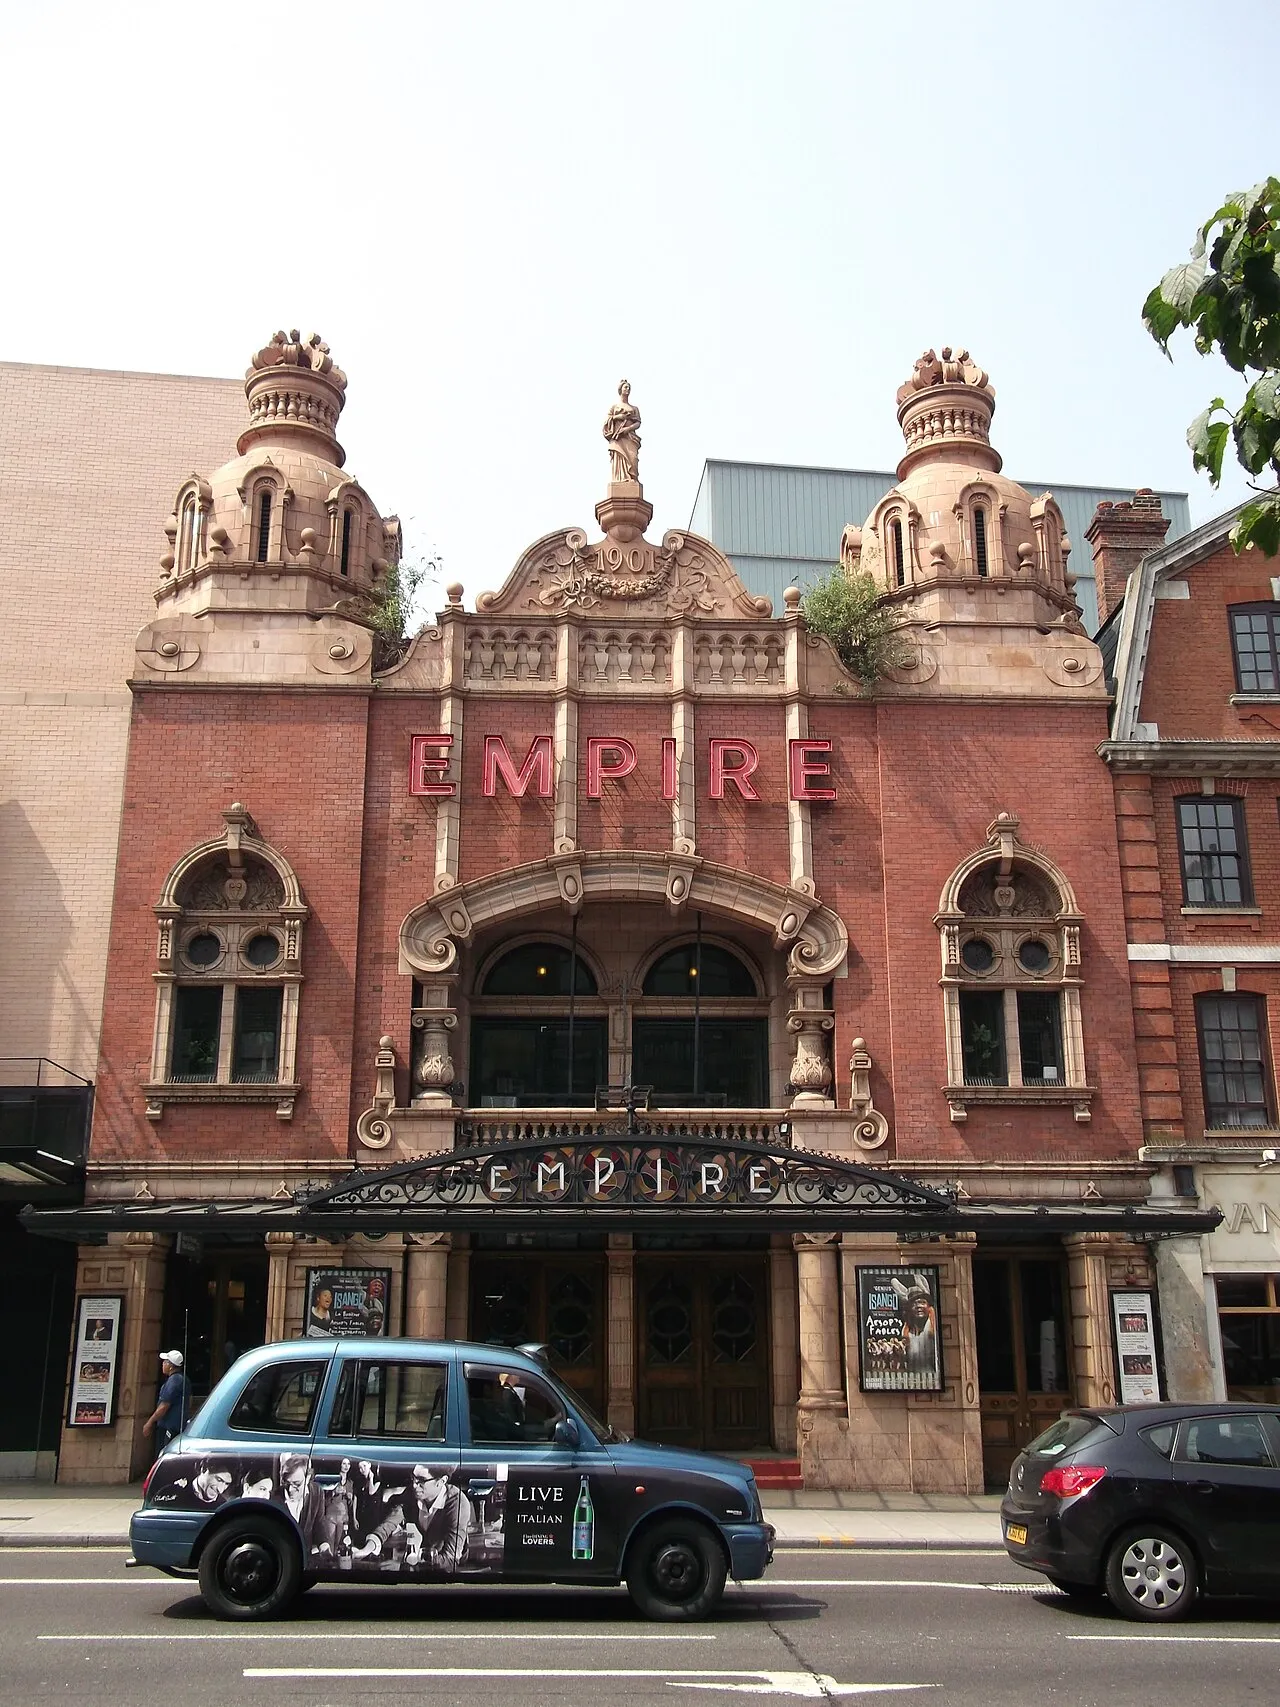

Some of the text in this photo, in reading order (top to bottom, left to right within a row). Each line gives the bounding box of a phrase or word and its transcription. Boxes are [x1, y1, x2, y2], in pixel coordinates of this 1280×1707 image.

[595, 547, 656, 574] 1901
[409, 733, 839, 802] EMPIRE
[490, 1157, 774, 1195] EMPIRE
[868, 1292, 898, 1310] ISANGO
[518, 1486, 564, 1502] LIVE
[517, 1514, 562, 1523] ITALIAN
